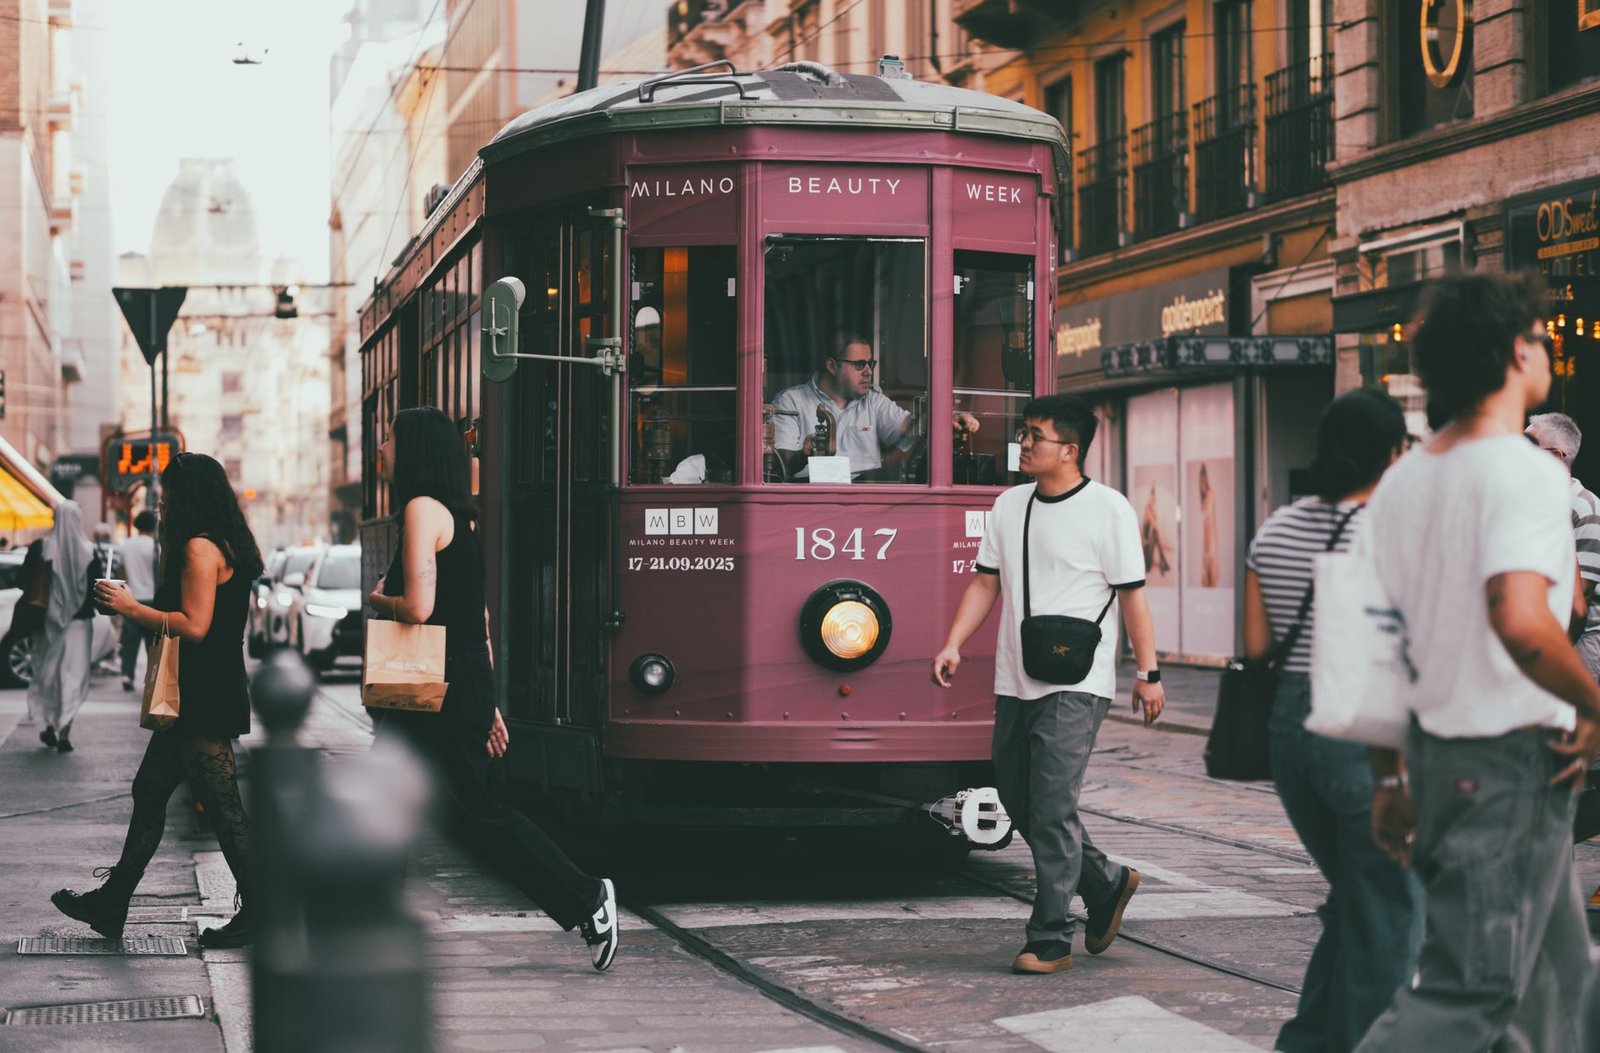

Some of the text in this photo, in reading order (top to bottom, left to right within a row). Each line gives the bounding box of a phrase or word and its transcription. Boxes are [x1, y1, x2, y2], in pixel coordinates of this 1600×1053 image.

[631, 177, 1021, 204] MILANO BEAUTY WEEK
[1162, 289, 1225, 338] goldenpoint
[1057, 317, 1102, 358] oldenpoint
[629, 538, 735, 547] MILANO BEAUTY WEEK
[794, 527, 898, 560] 1847
[628, 557, 735, 571] 17-21.09.2025
